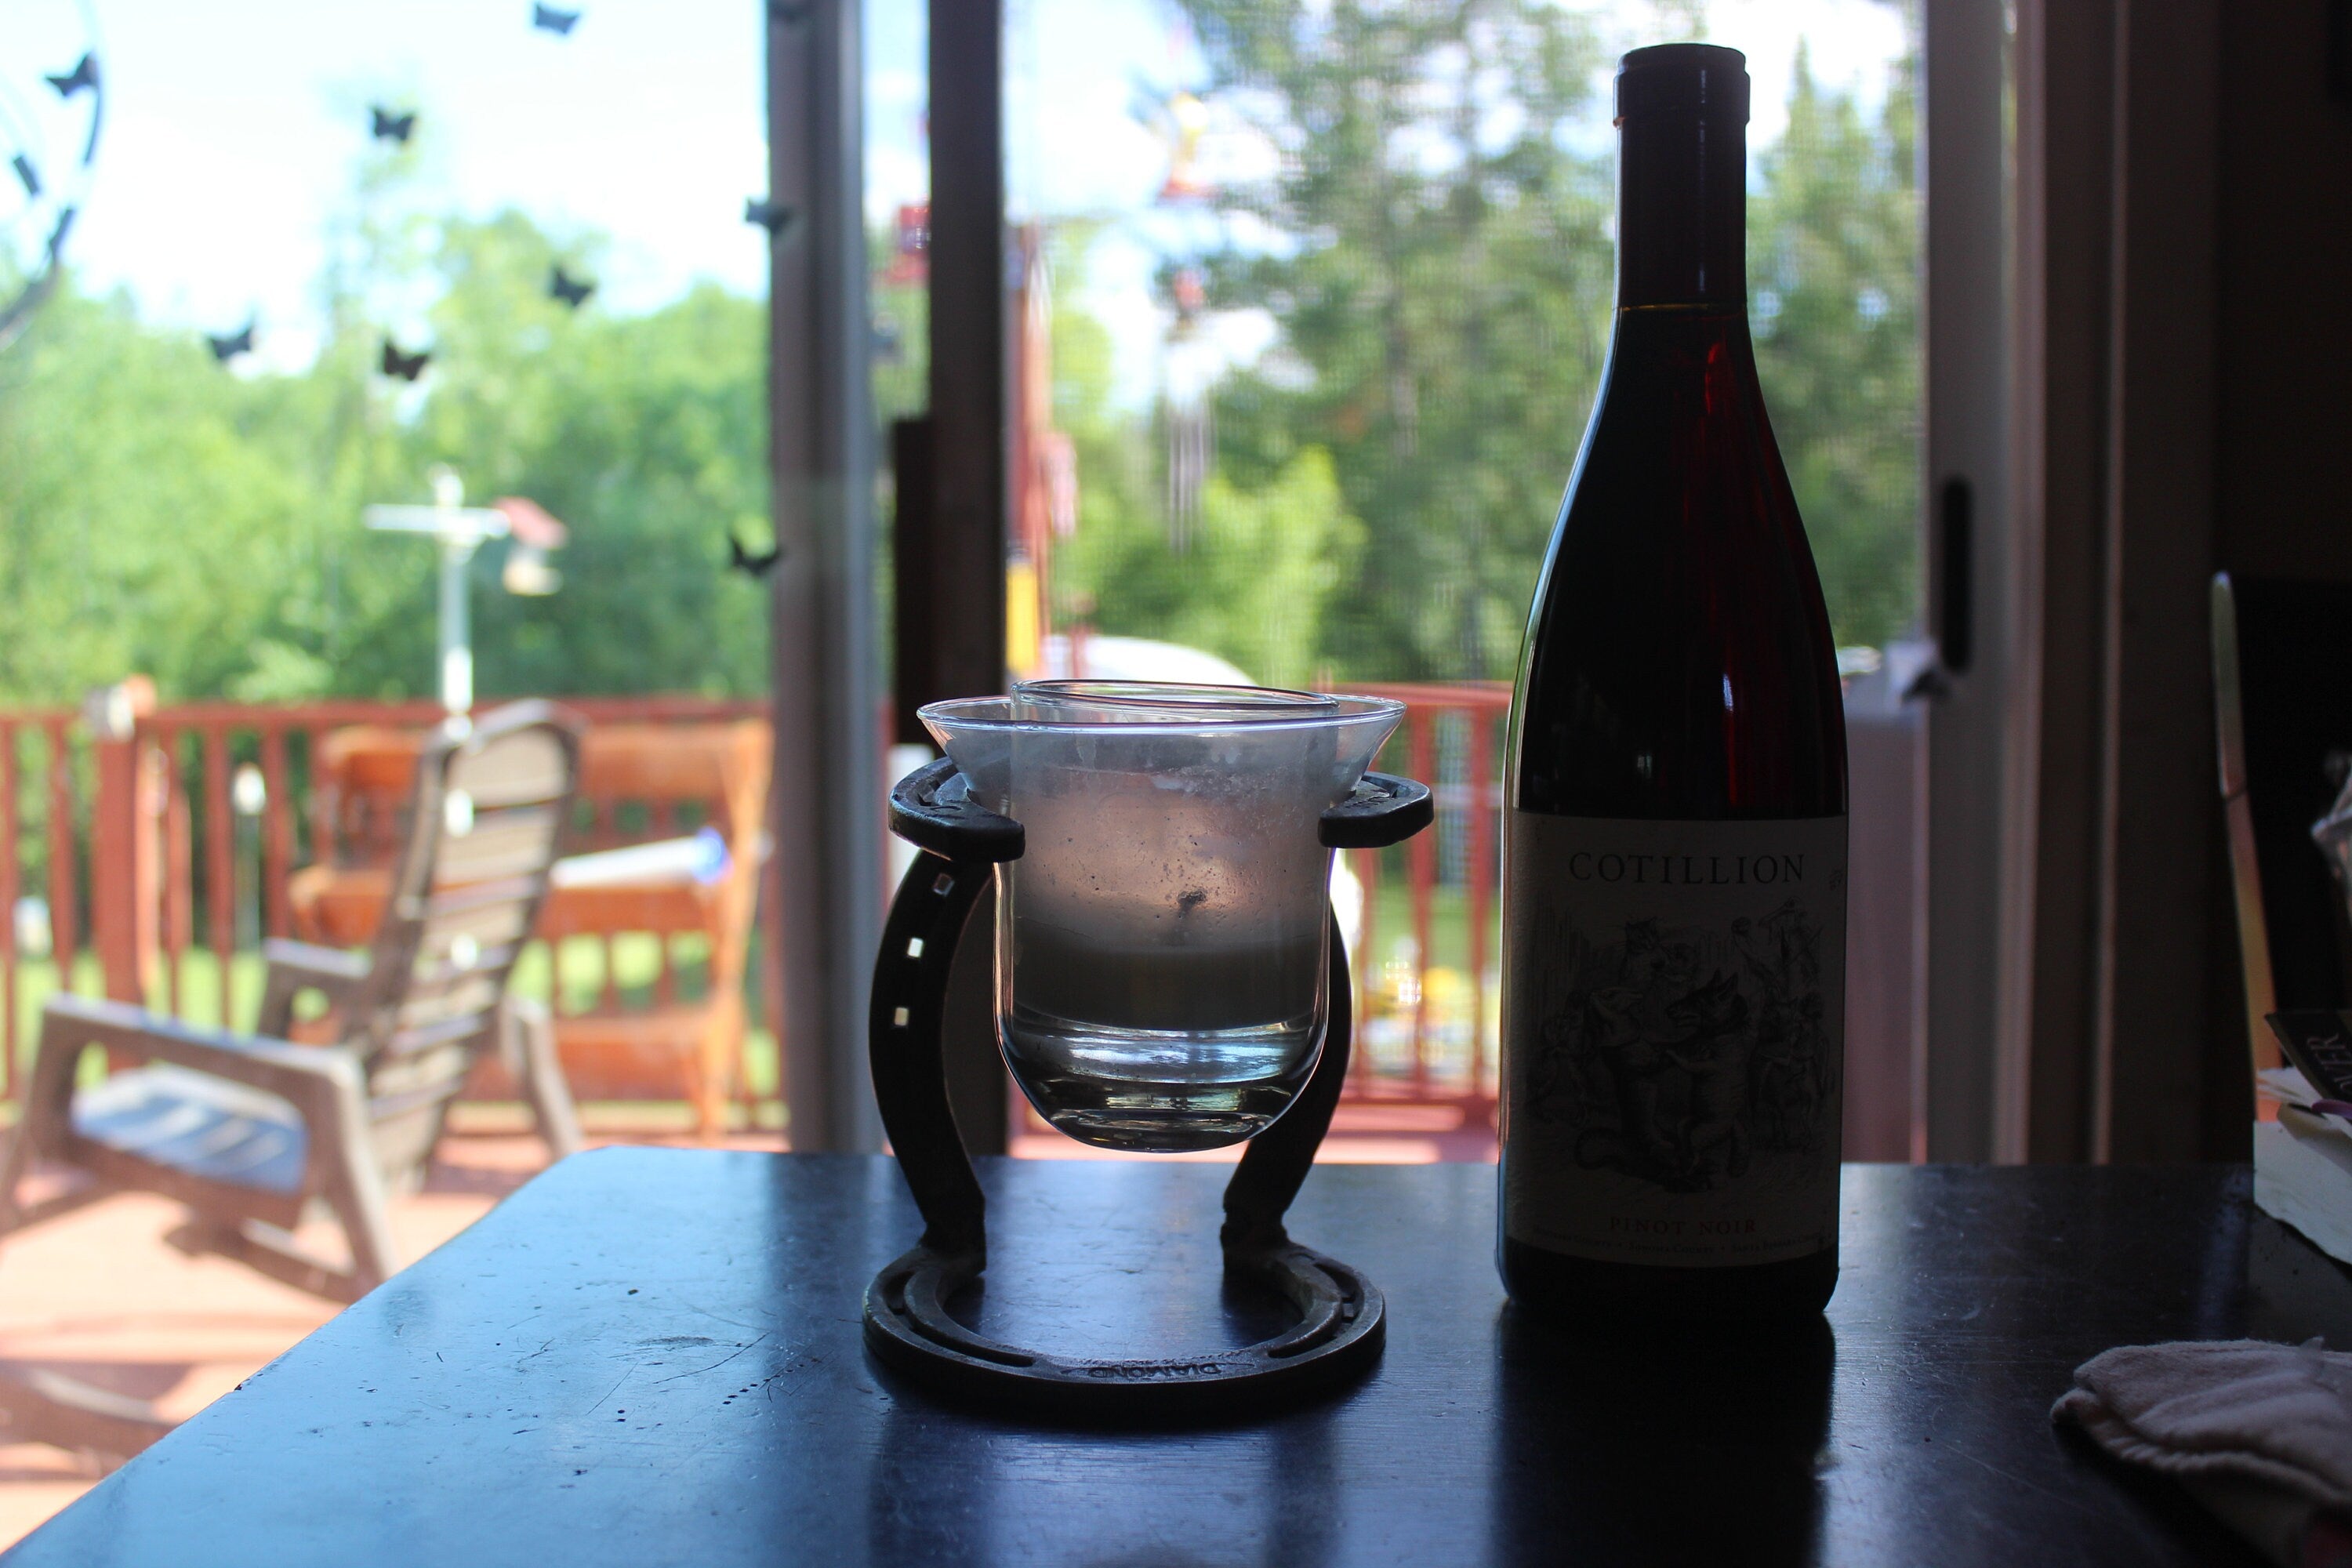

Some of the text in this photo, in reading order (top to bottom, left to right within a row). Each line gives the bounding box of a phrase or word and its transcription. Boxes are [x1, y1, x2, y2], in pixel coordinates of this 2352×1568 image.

[1569, 851, 1804, 885] COTILLION
[1610, 1216, 1757, 1236] PINOT NOIR
[1087, 1363, 1221, 1379] DIAMOND
